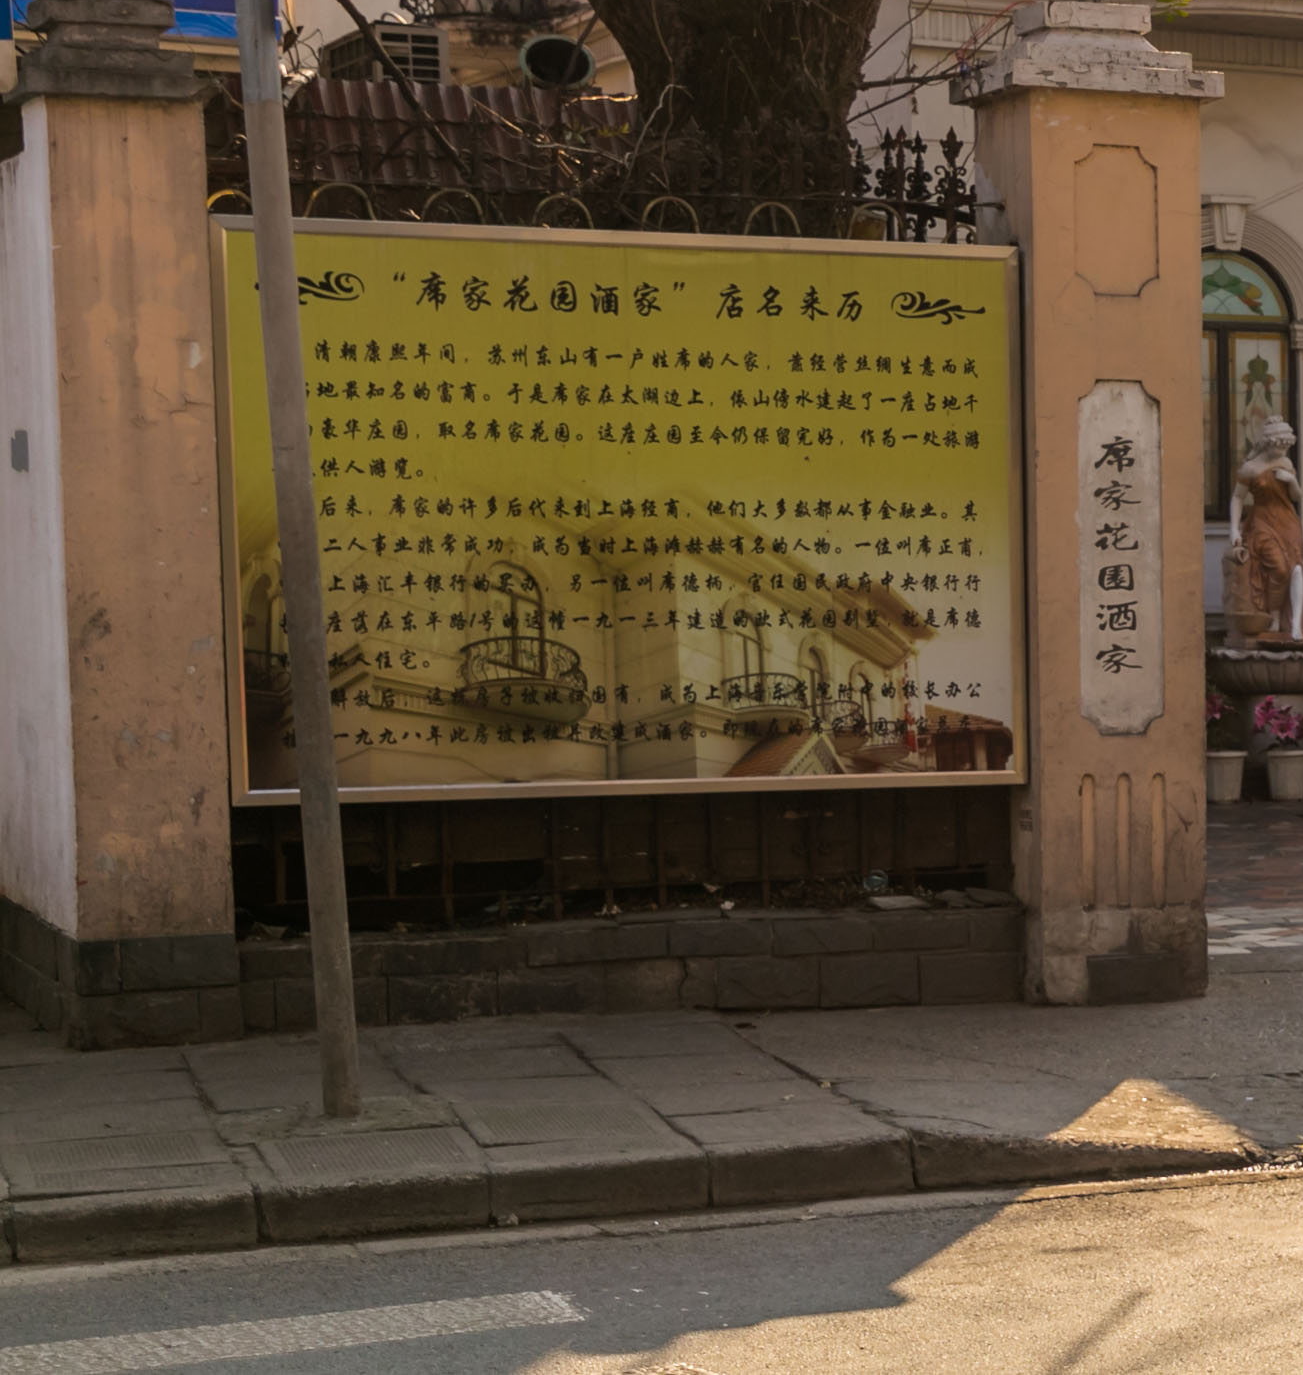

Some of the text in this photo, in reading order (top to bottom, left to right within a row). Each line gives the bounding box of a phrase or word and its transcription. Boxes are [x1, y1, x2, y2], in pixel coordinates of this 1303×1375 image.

[309, 417, 981, 450] 豪华庄园，取名席家花园。这座庄园至今仍保留完好，作为一处旅游
[312, 457, 425, 481] 供人游览。
[279, 532, 984, 558] 二人事业非常成功，成为当时上海滩赫赫有名的人物。一位叫席正甫，
[1094, 435, 1143, 674] 席家花園酒家
[280, 571, 982, 594] 上海汇丰银行的买办，另一位叫席德柄，官任国民政府中央银行行
